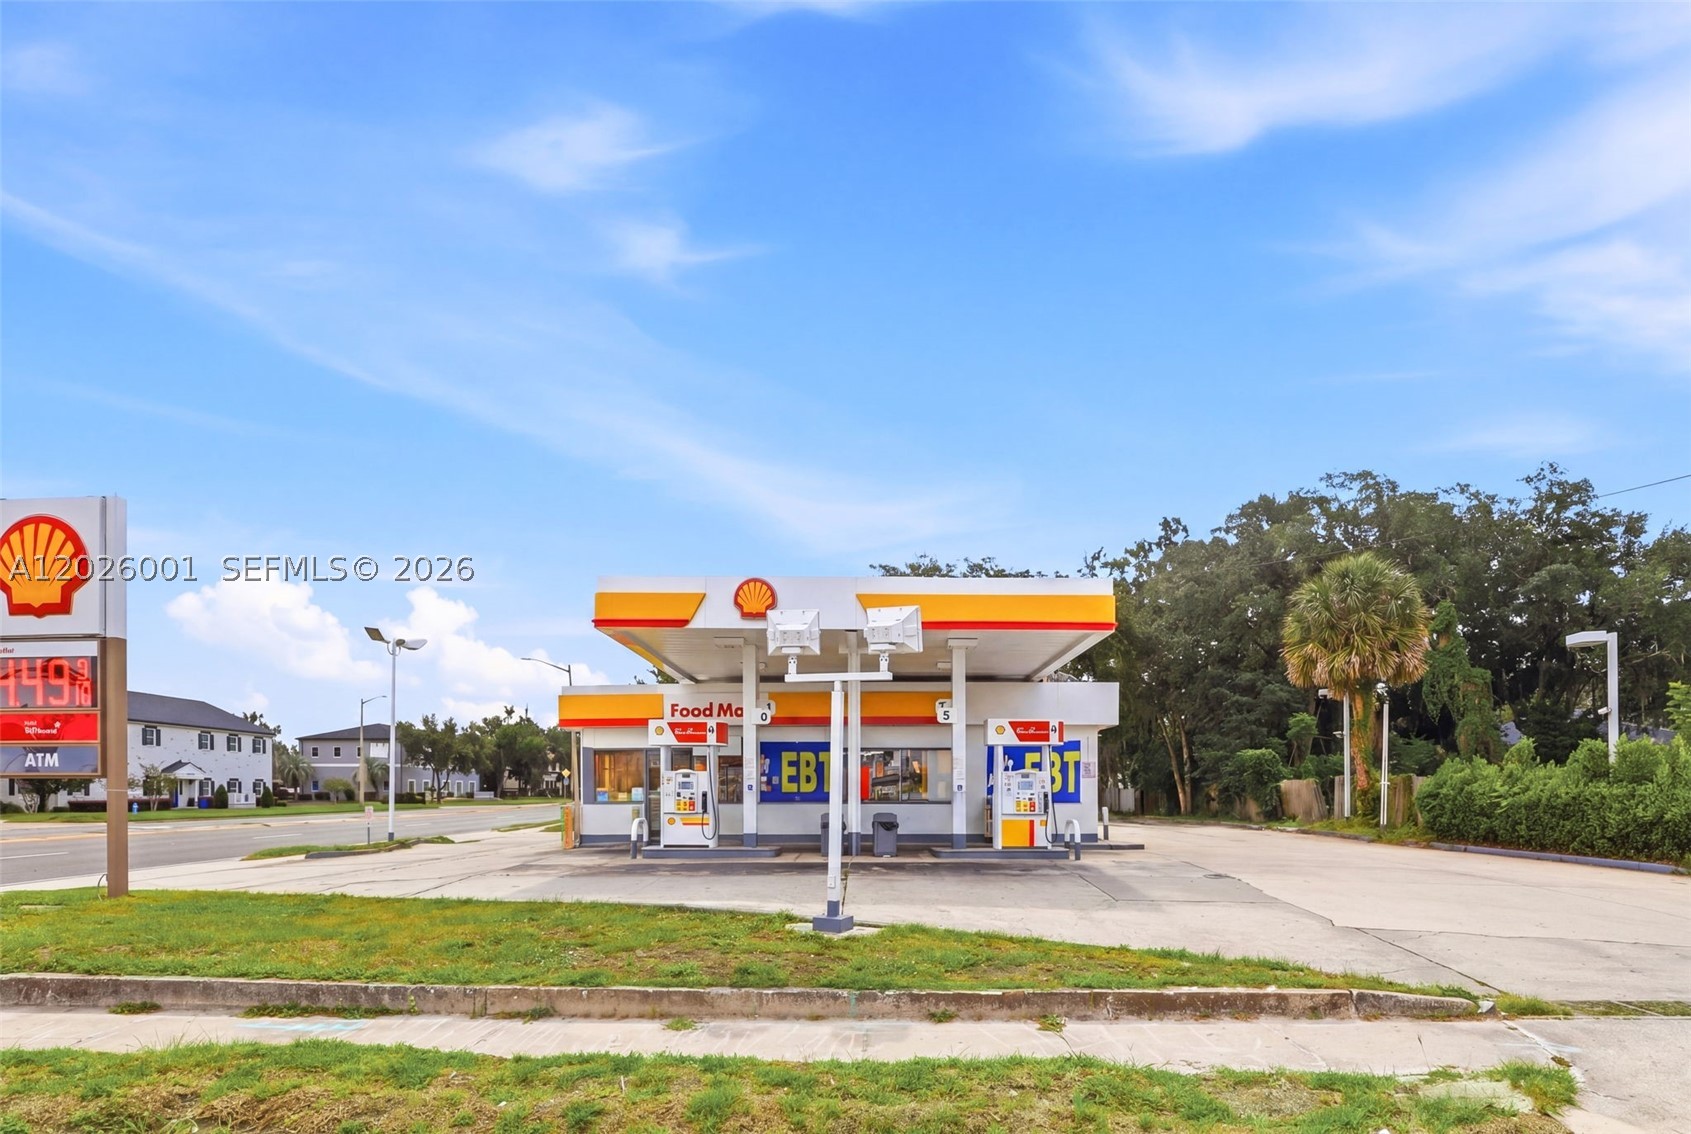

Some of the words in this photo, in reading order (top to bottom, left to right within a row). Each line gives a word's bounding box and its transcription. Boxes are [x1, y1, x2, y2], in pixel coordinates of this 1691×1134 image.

[670, 702, 713, 718] Food
[717, 702, 744, 718] Ma
[760, 712, 768, 722] 0
[943, 710, 950, 721] 5
[24, 752, 59, 768] ATM
[781, 751, 831, 793] EBT
